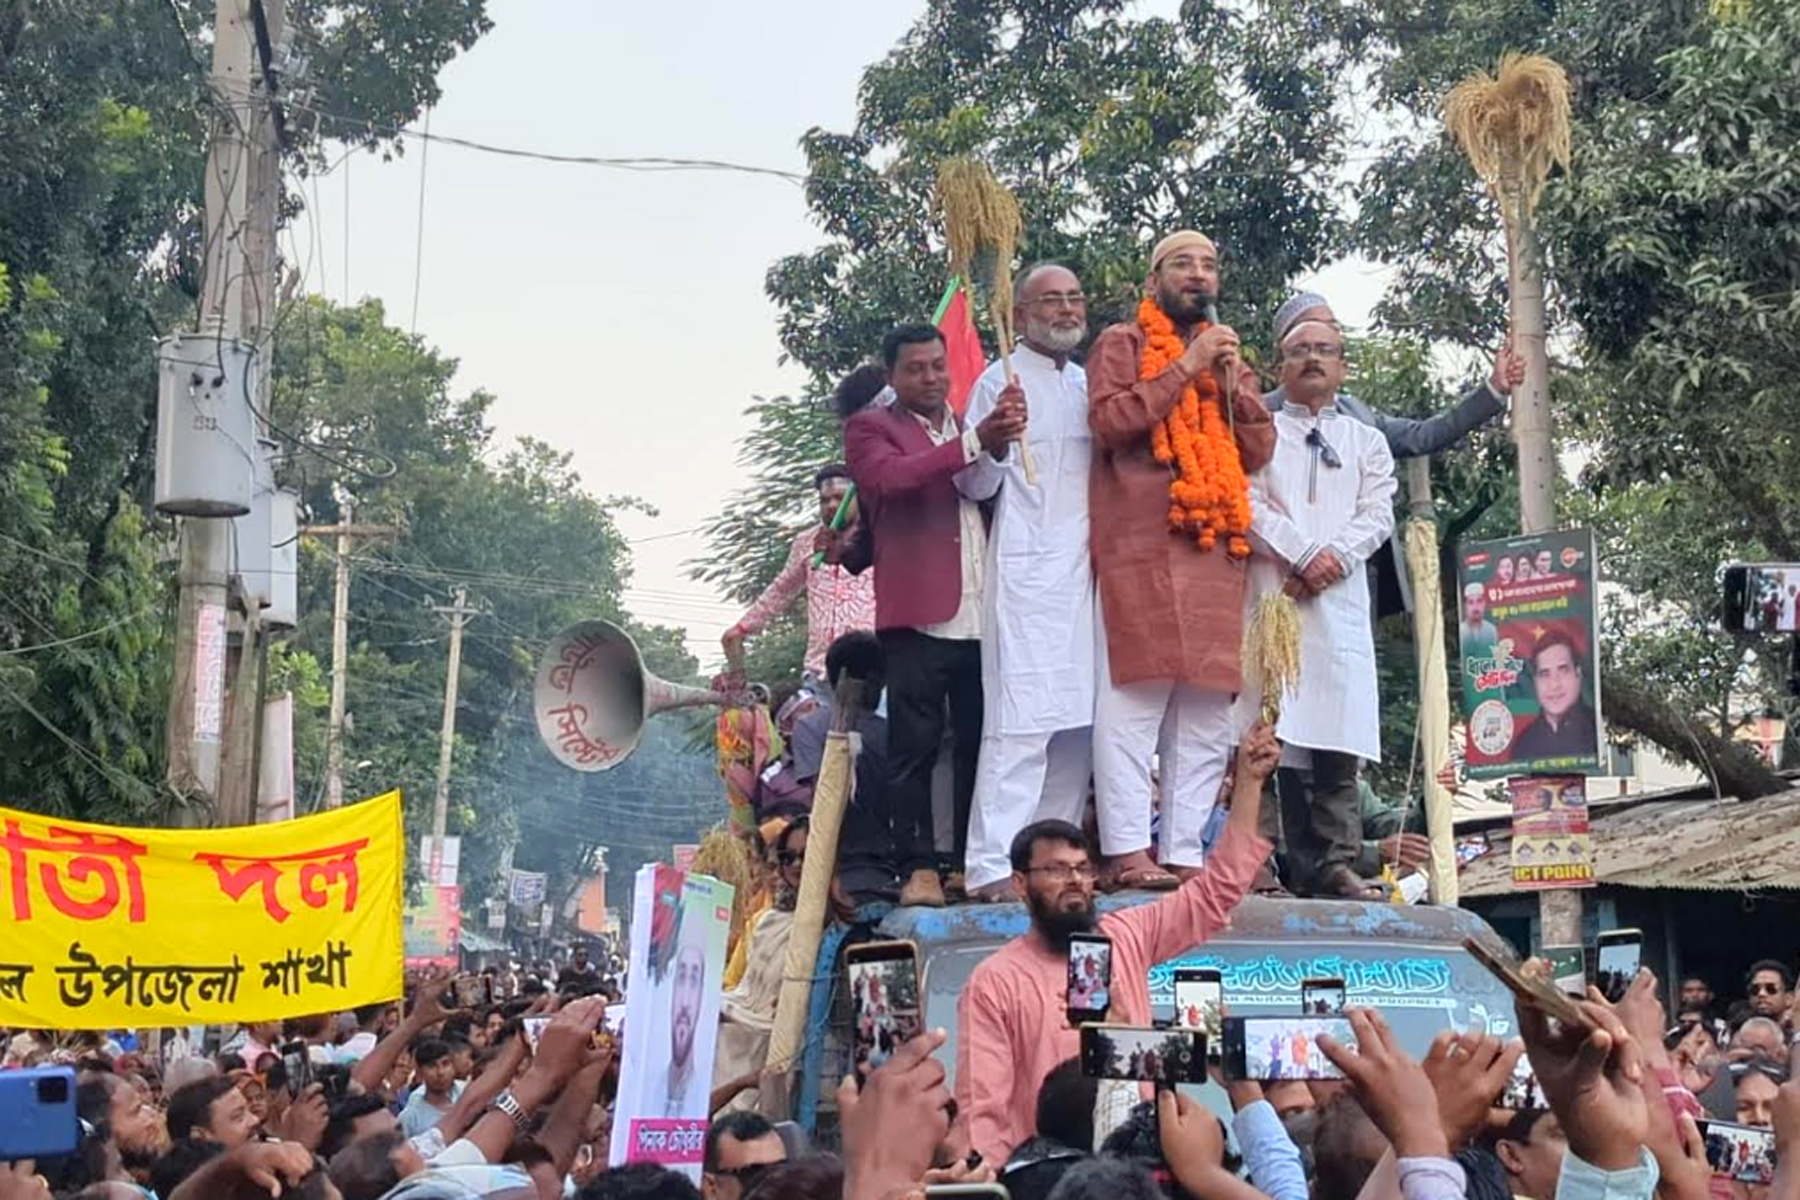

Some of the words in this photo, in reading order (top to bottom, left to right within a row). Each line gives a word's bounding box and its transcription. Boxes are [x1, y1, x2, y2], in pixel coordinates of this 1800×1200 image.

[0, 817, 148, 923] াতী
[194, 837, 369, 924] দল
[1514, 866, 1540, 881] ICT
[1542, 863, 1591, 880] POINT
[0, 963, 34, 1004] ল
[55, 941, 243, 1013] উপজেলা
[260, 939, 353, 997] শাখা
